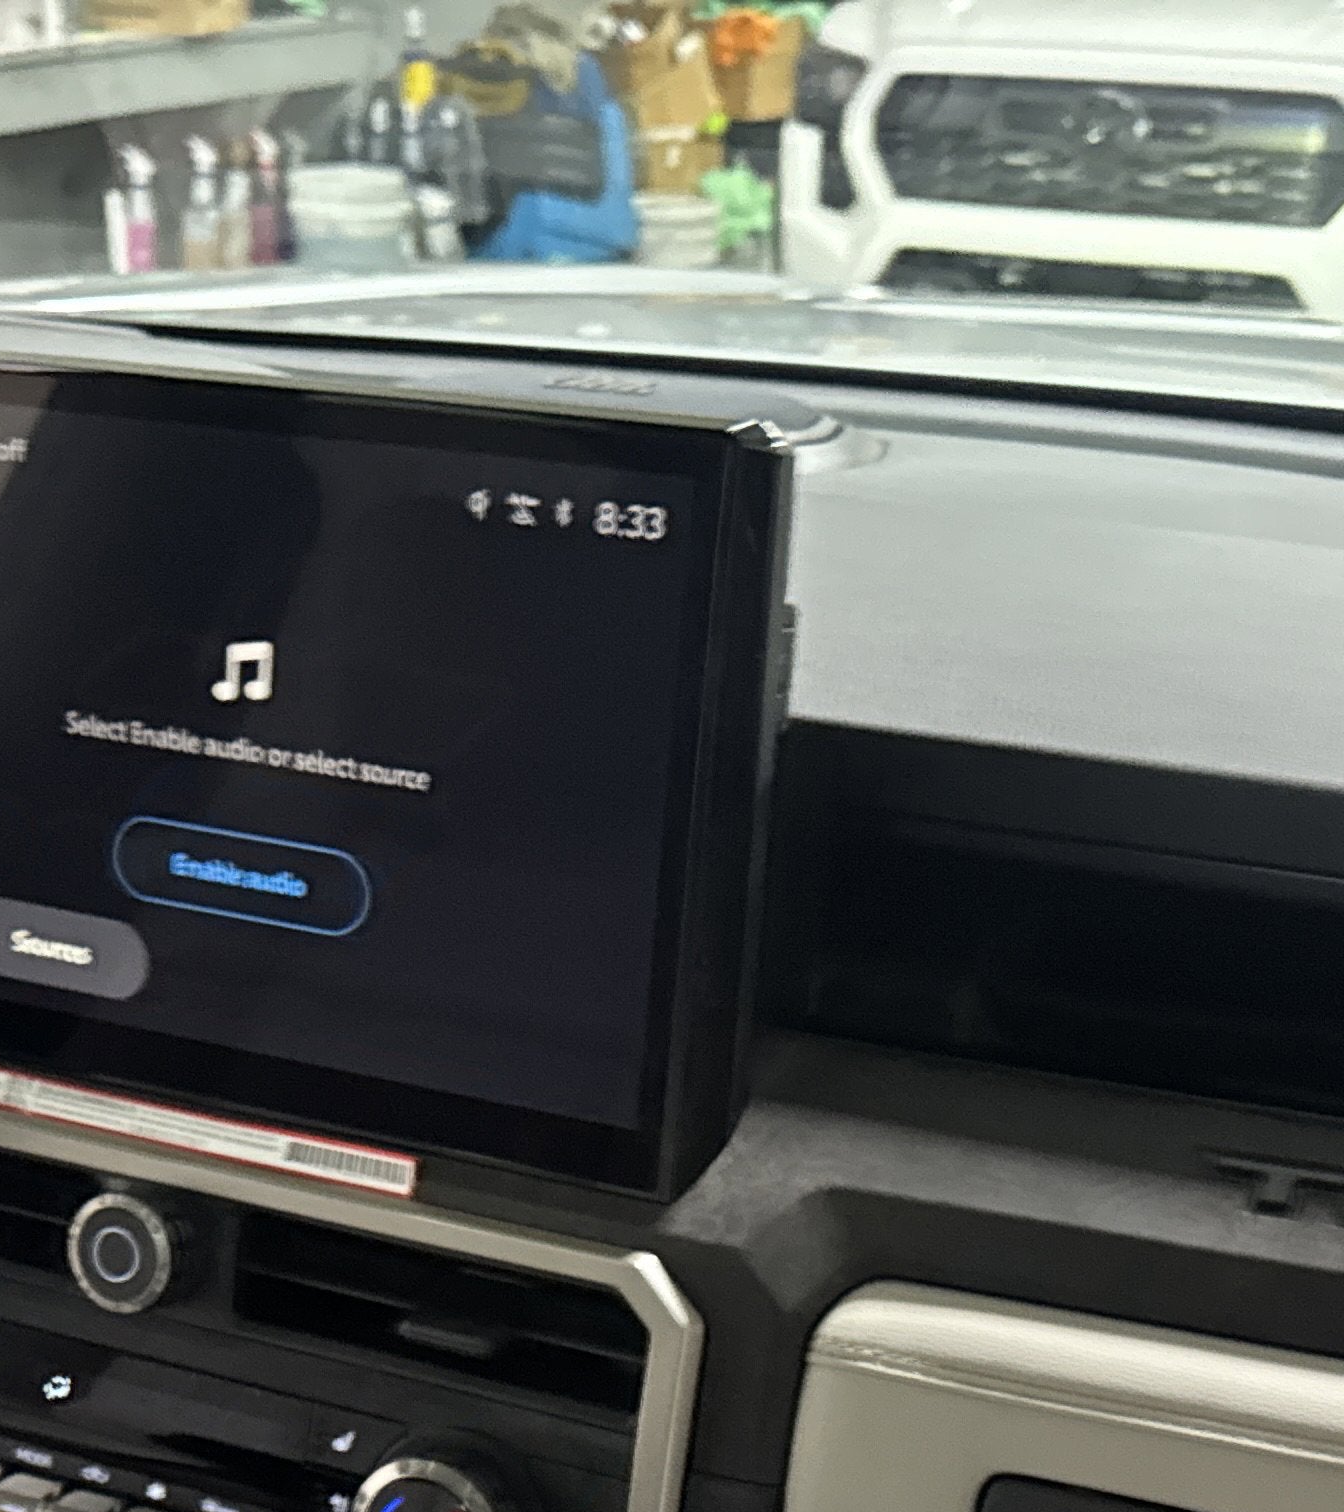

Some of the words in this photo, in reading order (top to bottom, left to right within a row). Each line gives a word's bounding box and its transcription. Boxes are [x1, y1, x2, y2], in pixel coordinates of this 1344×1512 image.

[593, 500, 668, 541] 8:33
[64, 708, 127, 742] Select
[130, 720, 202, 756] Enable
[204, 736, 261, 764] audio
[266, 746, 293, 769] or
[294, 749, 358, 780] select
[359, 763, 433, 793] source
[168, 850, 240, 887] Enable
[241, 870, 309, 899] audio
